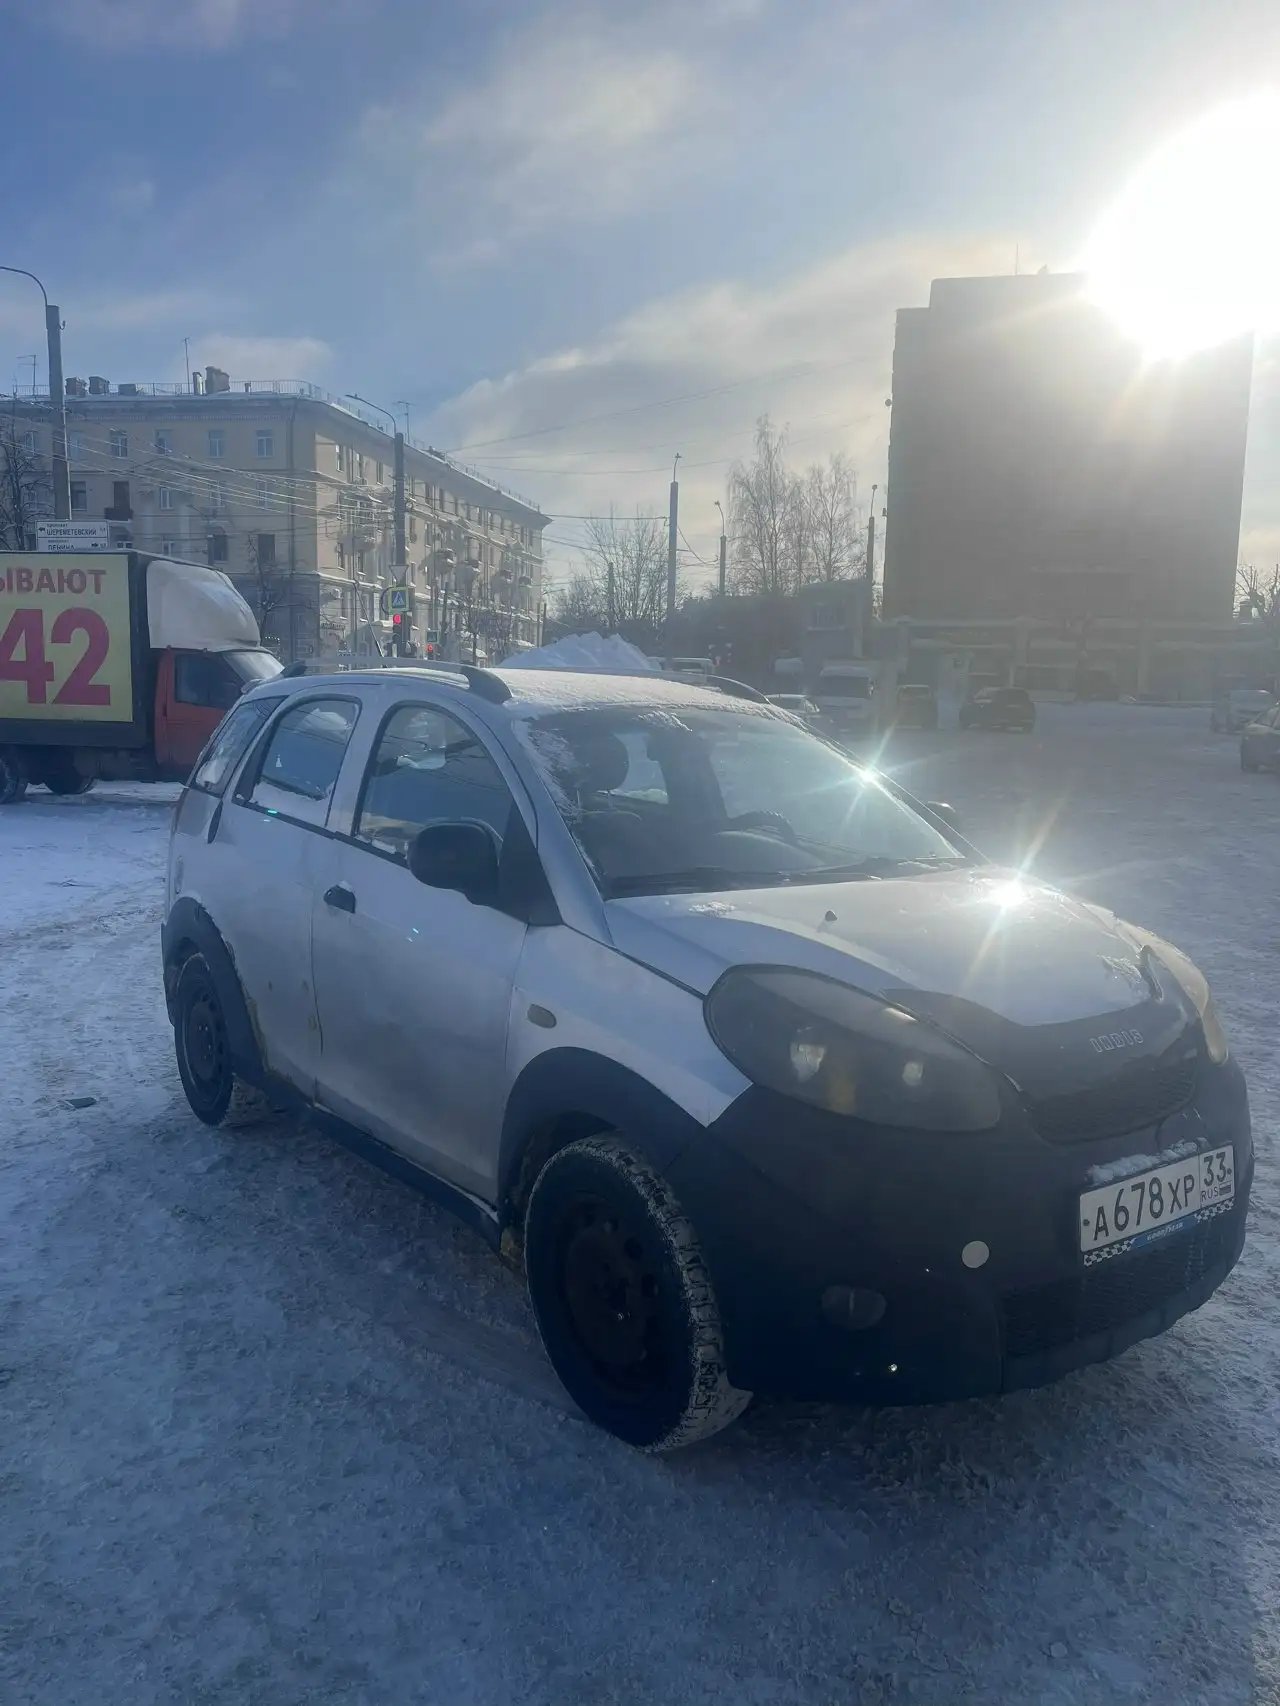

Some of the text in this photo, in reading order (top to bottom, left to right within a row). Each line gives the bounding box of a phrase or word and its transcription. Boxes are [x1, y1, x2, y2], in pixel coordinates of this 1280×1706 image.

[47, 527, 97, 536] ШЕРЕМЕТЕВСКИЙ
[0, 607, 111, 706] 42
[1094, 1152, 1226, 1241] А678ХР 33
[1201, 1187, 1219, 1202] RUS
